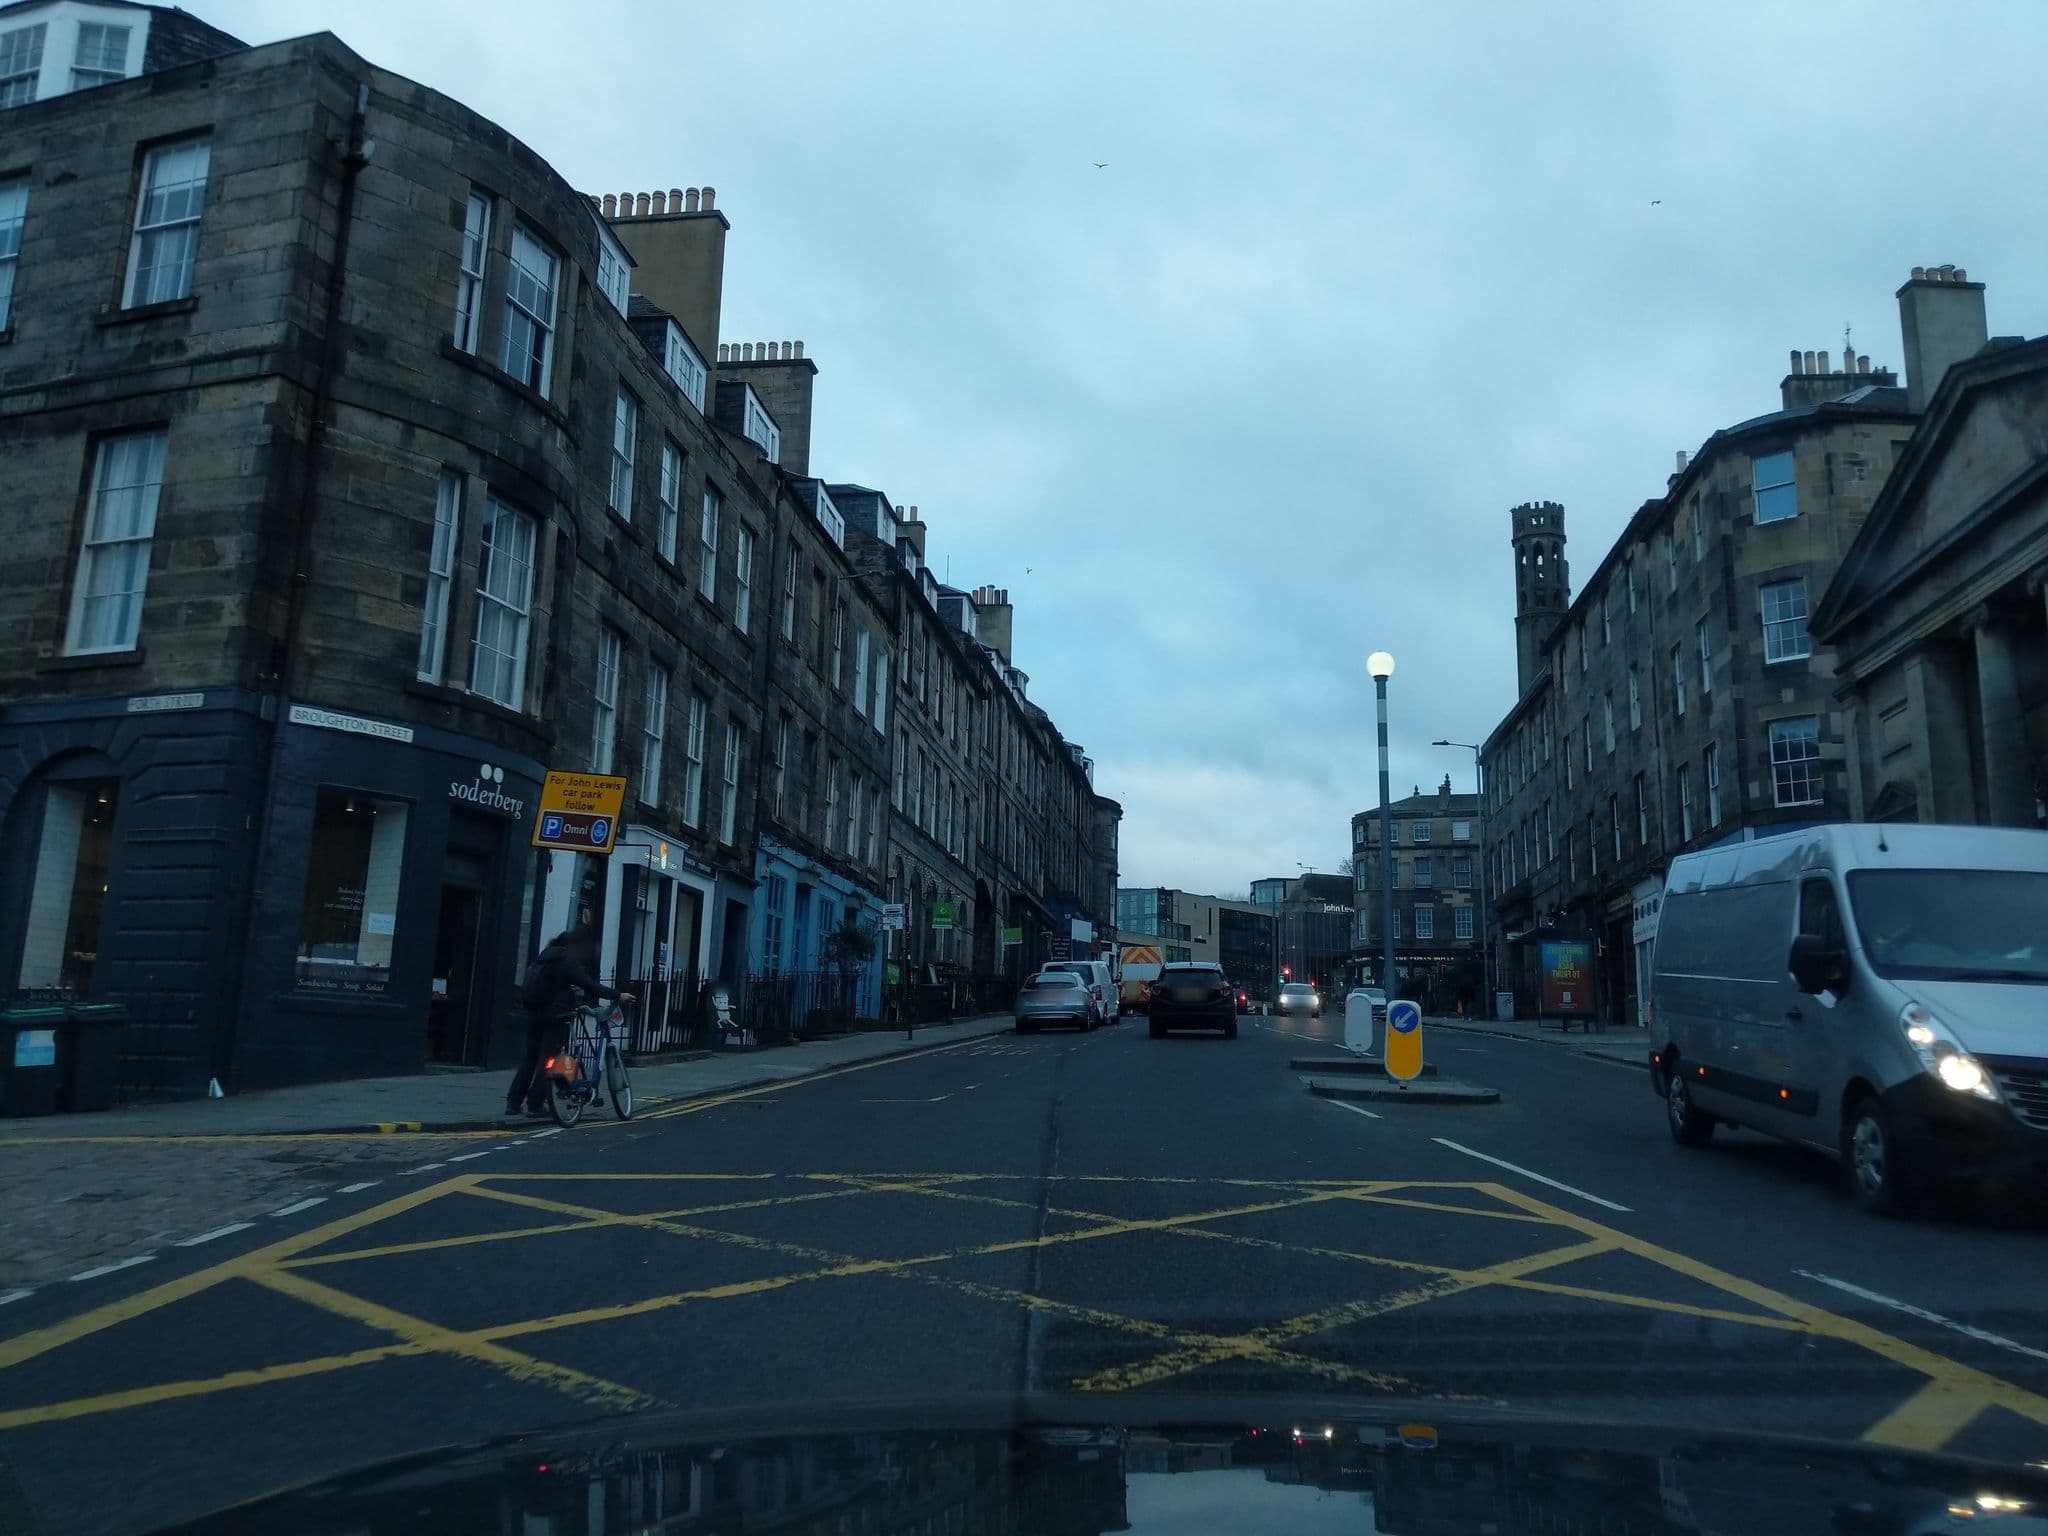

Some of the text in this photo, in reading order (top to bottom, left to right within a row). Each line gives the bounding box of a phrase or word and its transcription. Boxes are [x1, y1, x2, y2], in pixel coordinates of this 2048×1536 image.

[294, 709, 411, 741] BROUGHTON STREET
[550, 775, 622, 791] For John Lewis
[562, 789, 603, 800] car park
[565, 801, 596, 811] follow
[545, 818, 558, 836] P
[563, 823, 588, 835] Omni
[1323, 903, 1355, 913] John Lew
